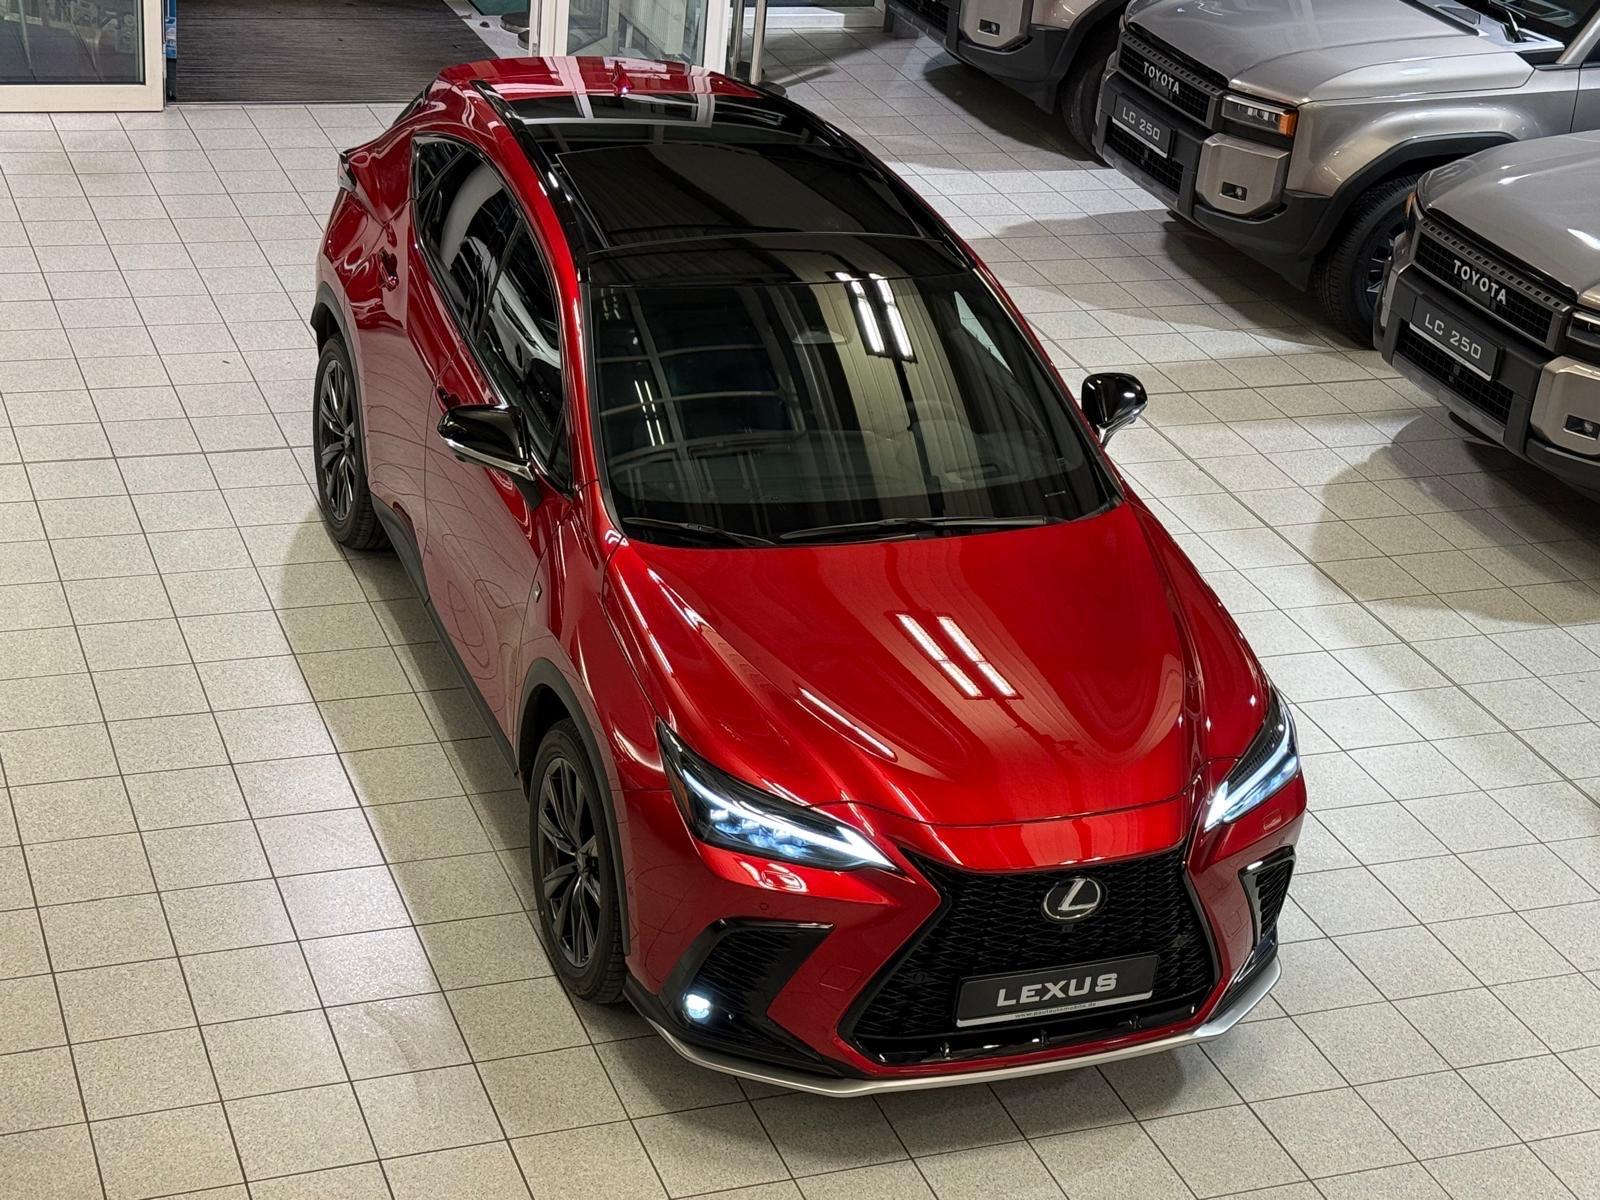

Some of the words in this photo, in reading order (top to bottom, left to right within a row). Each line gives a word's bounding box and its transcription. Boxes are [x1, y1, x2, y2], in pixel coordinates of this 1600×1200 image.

[1143, 61, 1179, 95] TOYOTA
[1122, 106, 1136, 124] LC
[1139, 118, 1160, 140] 250
[1453, 259, 1506, 305] TOYOTA
[1424, 313, 1445, 336] LC
[1449, 330, 1482, 360] 250
[996, 972, 1118, 1007] LEXUS
